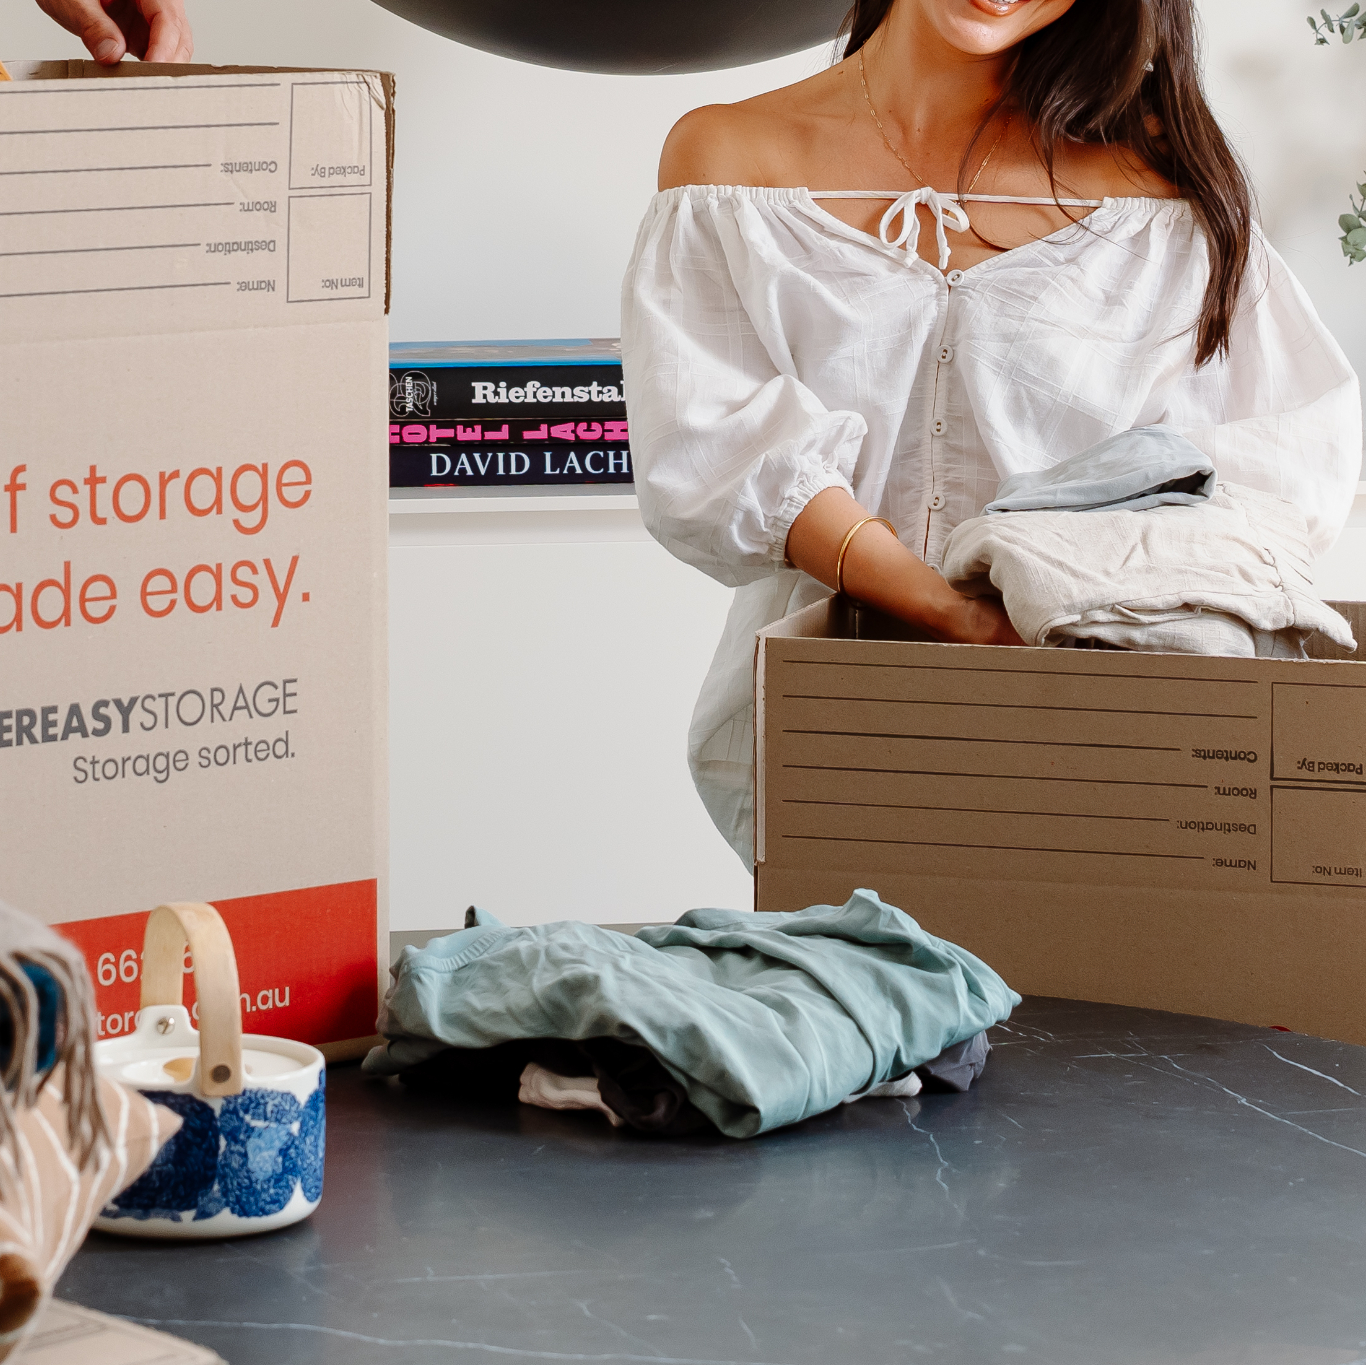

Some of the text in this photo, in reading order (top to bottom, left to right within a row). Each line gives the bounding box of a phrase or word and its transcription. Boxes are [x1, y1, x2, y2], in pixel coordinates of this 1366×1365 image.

[220, 160, 278, 174] Contents:
[311, 164, 366, 178] Packed By:
[239, 200, 277, 213] Room:
[206, 239, 276, 255] Destination:
[236, 279, 276, 292] Name:
[321, 276, 364, 290] Item No:
[405, 376, 413, 412] TASCHEN
[430, 450, 630, 477] DAVID LACH
[48, 459, 313, 536] storage
[139, 554, 311, 629] easy.
[73, 730, 296, 784] Storage sorted.
[1191, 748, 1258, 764] Contents:
[1297, 757, 1364, 776] Packed By:
[1214, 785, 1258, 800] Room:
[1177, 819, 1257, 835] Destination:
[1212, 857, 1257, 871] Name:
[1312, 865, 1363, 878] Item No:
